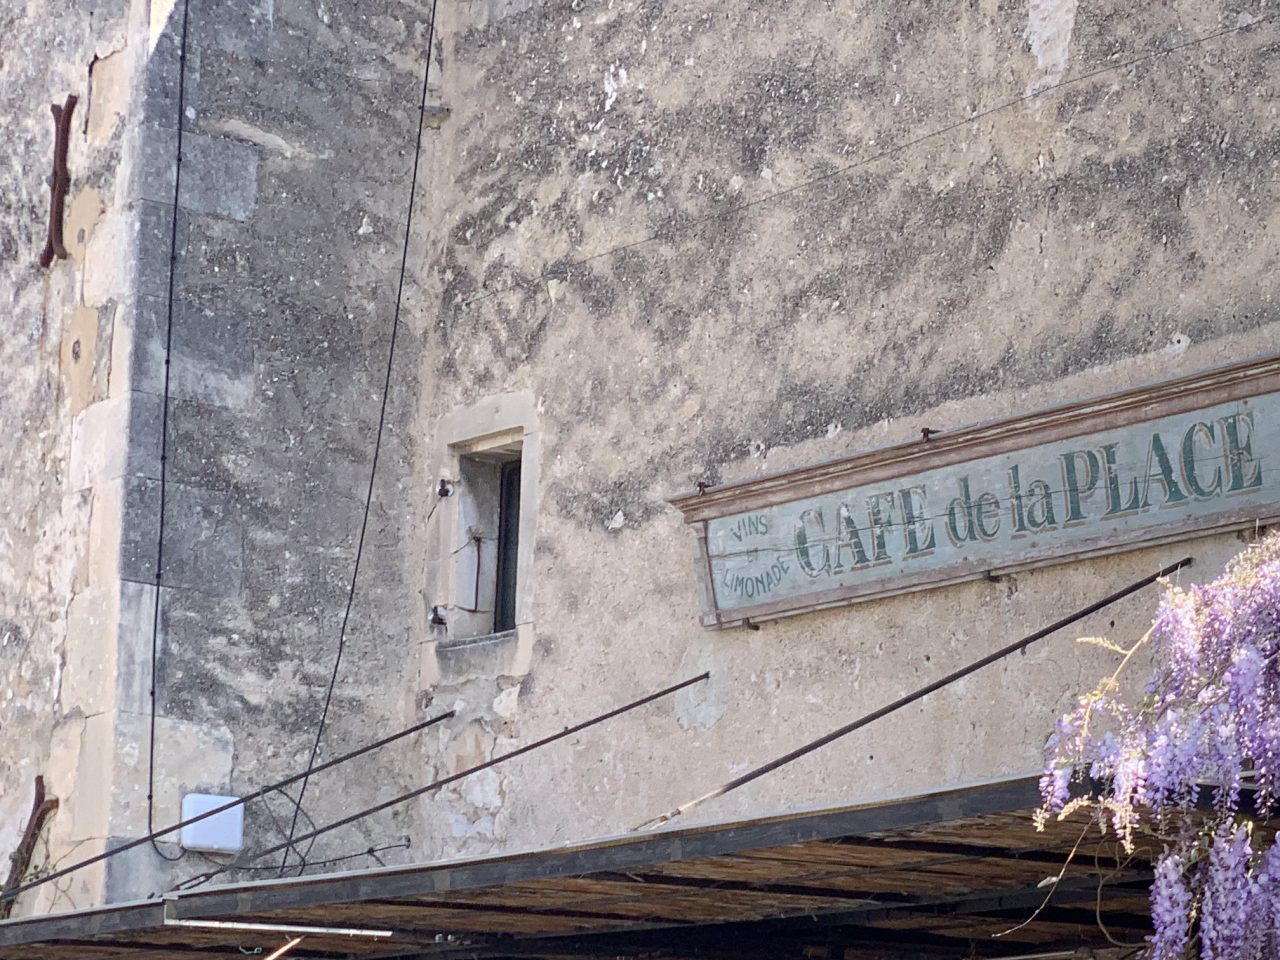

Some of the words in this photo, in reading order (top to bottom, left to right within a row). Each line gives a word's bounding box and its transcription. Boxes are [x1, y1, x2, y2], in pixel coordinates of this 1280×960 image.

[794, 484, 937, 578] CAFE
[945, 473, 1002, 547] de
[1007, 463, 1058, 539] la
[1058, 411, 1263, 529] PLACE
[730, 514, 769, 543] VINS
[722, 555, 791, 598] LIMONADE
